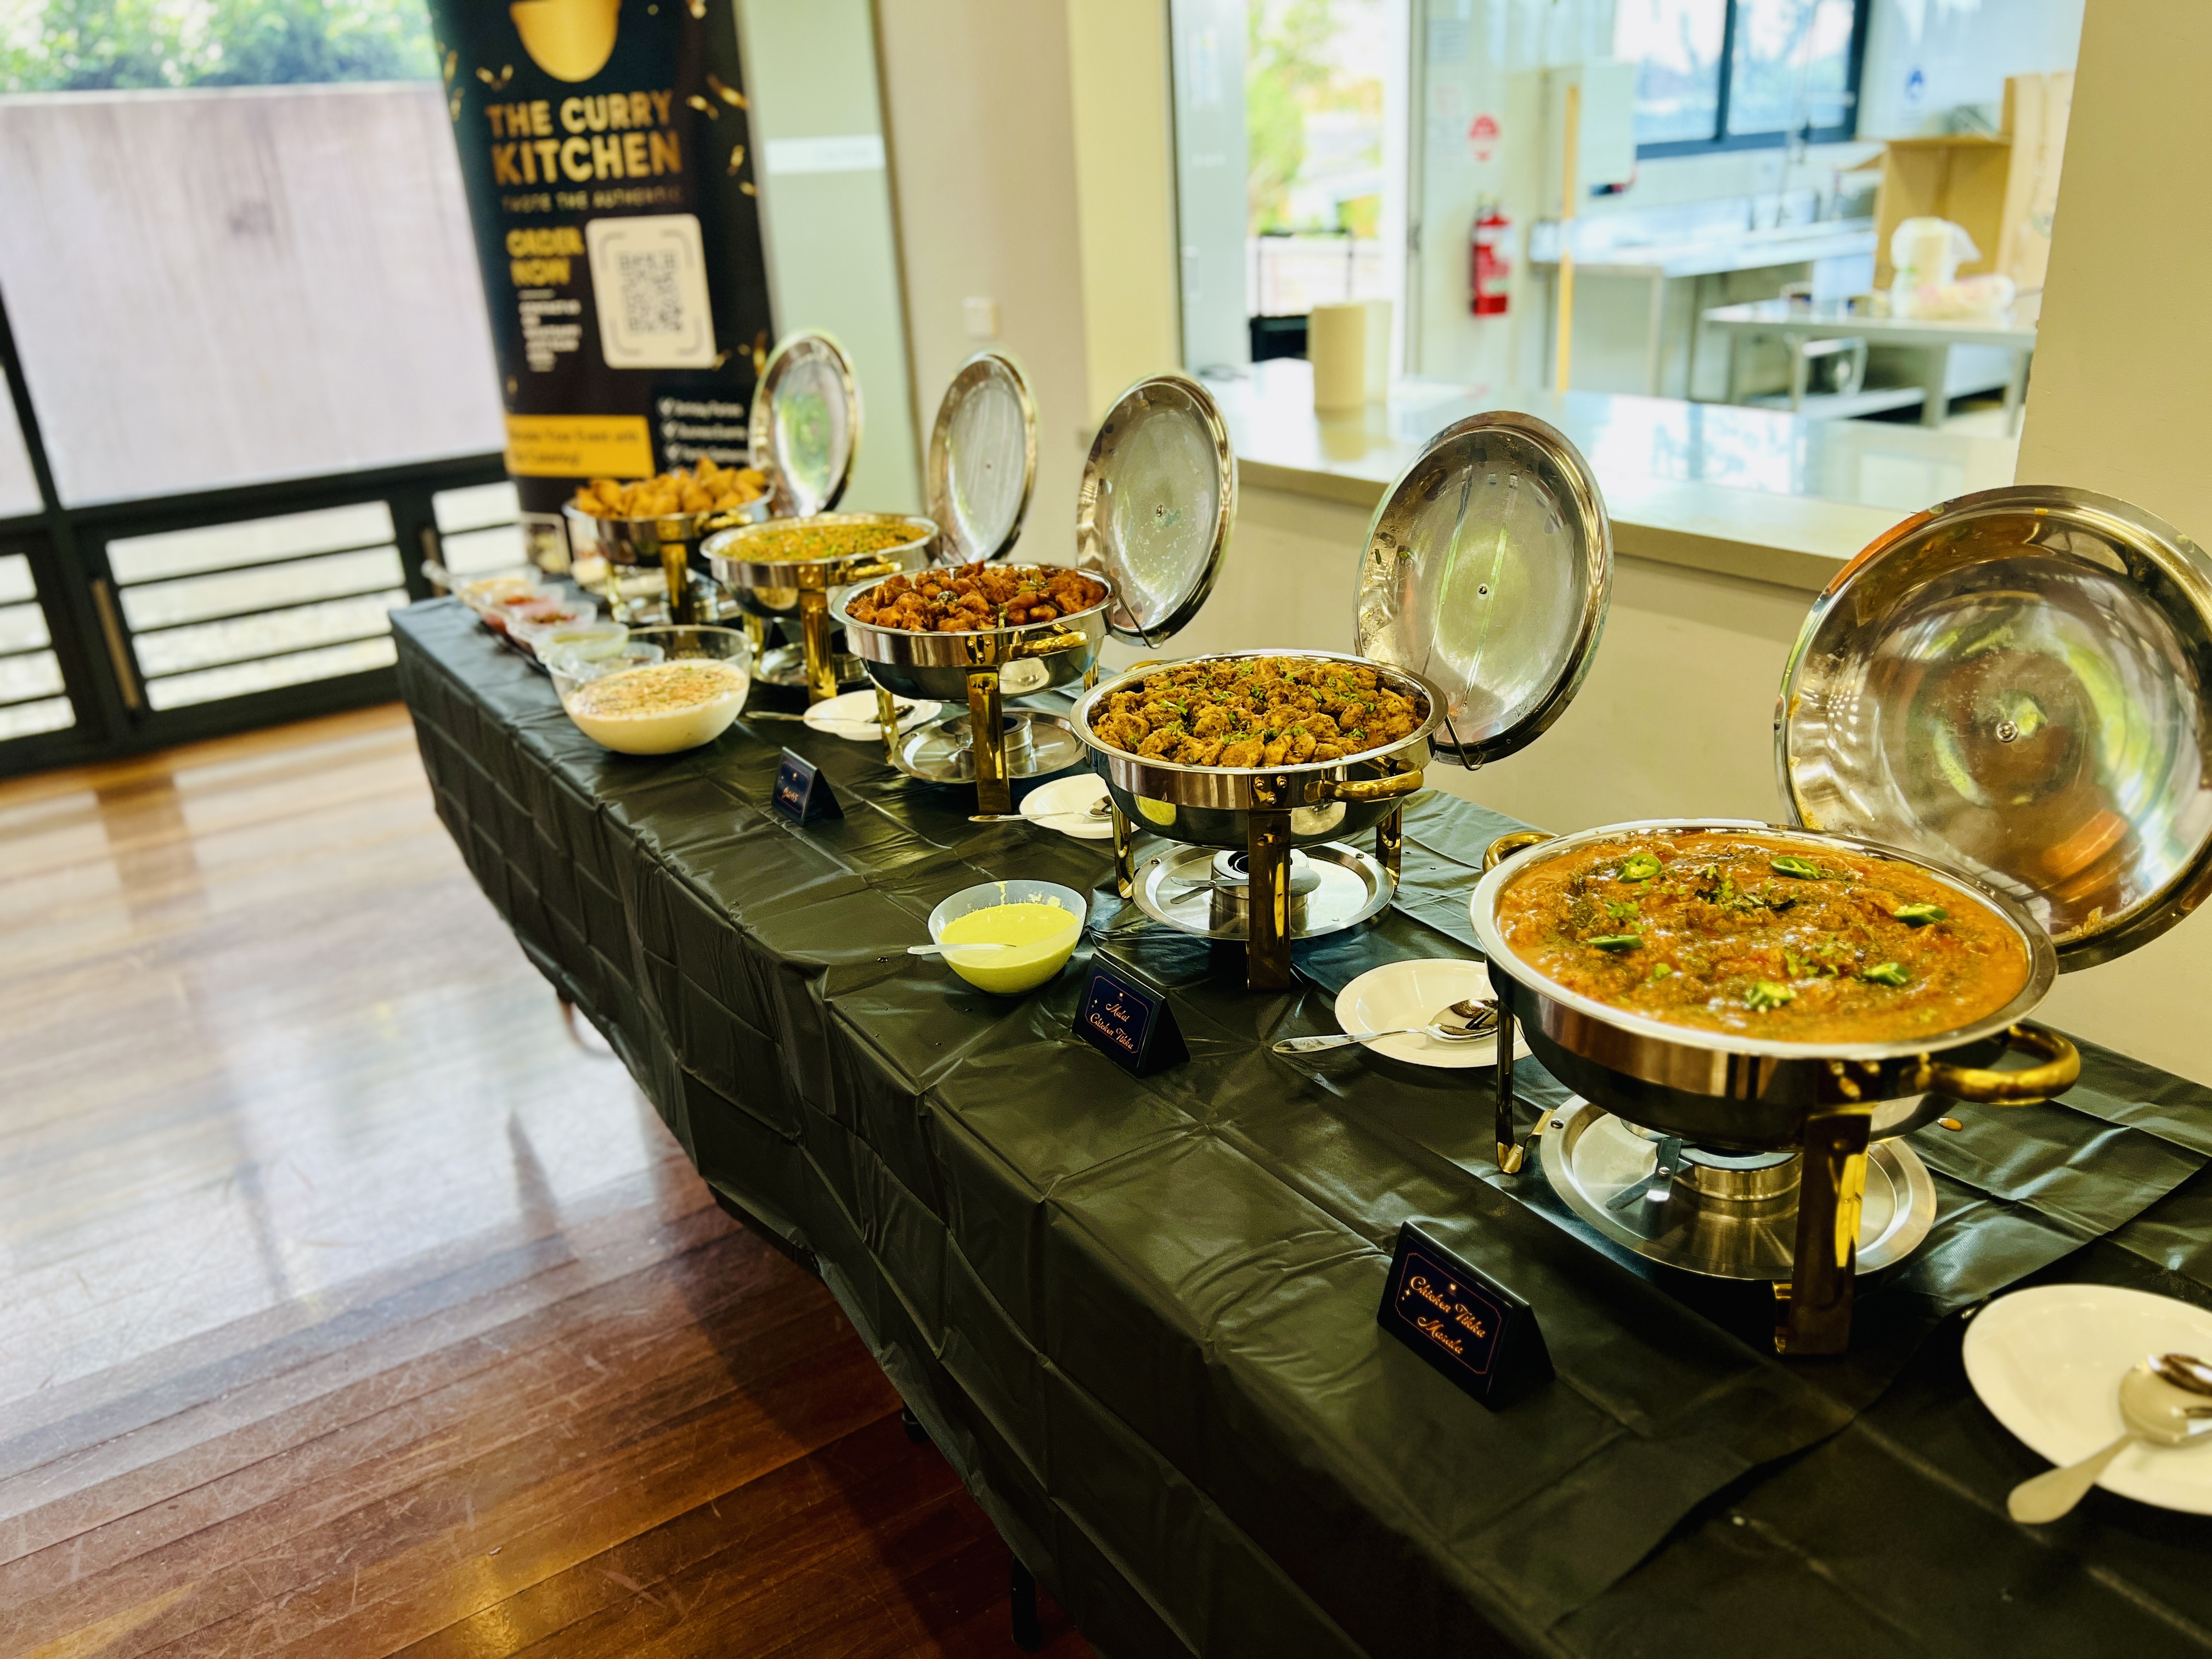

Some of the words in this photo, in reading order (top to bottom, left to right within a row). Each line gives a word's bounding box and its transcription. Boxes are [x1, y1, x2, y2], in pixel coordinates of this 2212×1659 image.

[486, 100, 553, 138] THE
[560, 89, 672, 133] CURRY
[492, 129, 682, 186] KITCHEN
[501, 193, 551, 212] TASTE
[555, 190, 589, 211] THE
[506, 226, 585, 257] ORDER
[510, 258, 571, 287] NOW
[1090, 1013, 1114, 1036] Chicken
[1116, 1028, 1133, 1049] Tikka
[1410, 1276, 1452, 1313] Chicken
[1455, 1304, 1486, 1338] Tikka
[1417, 1317, 1464, 1354] Masala
